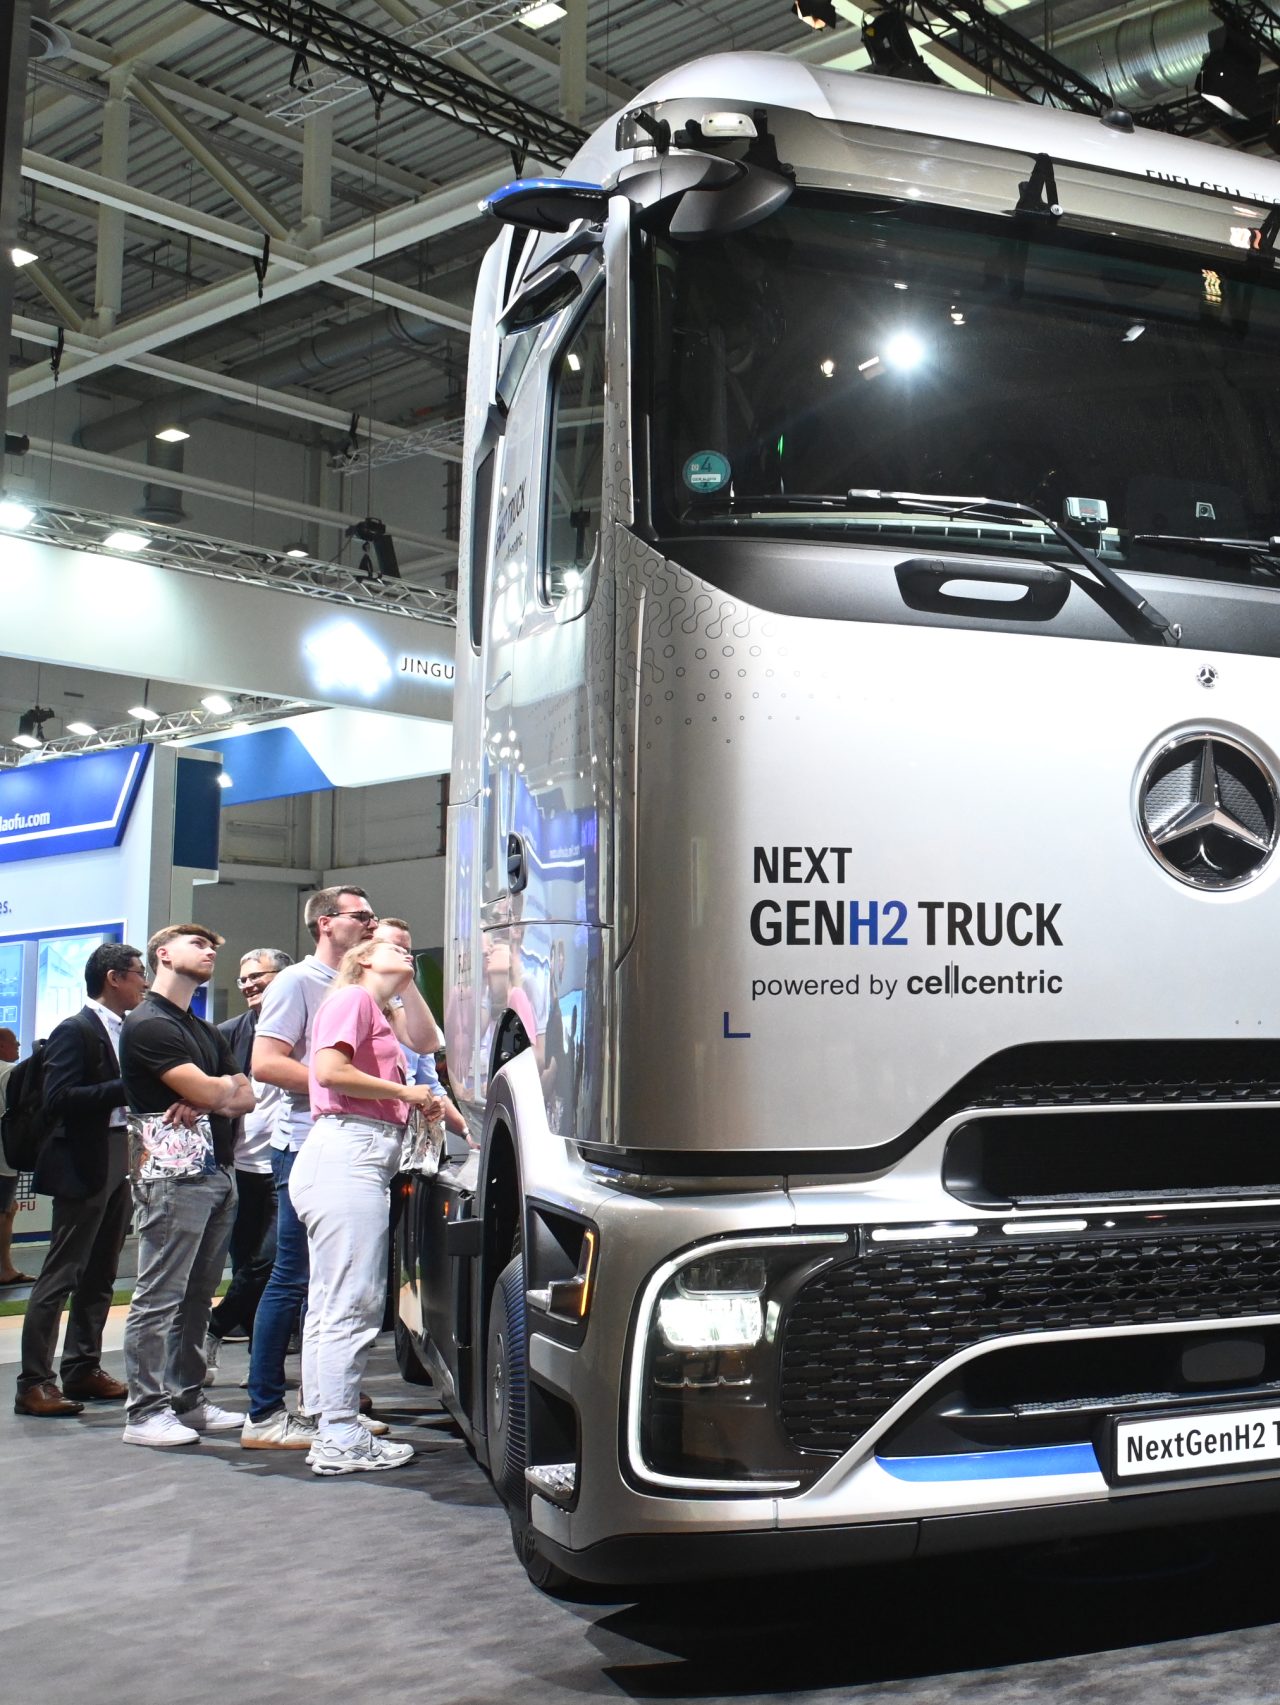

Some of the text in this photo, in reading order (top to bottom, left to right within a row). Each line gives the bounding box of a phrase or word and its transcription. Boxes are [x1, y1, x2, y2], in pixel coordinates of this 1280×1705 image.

[700, 456, 712, 472] 4
[401, 657, 455, 680] JINGU
[753, 846, 852, 884] NEXT
[750, 899, 1064, 947] GENH2 TRUCK
[752, 962, 1063, 1001] powered by cellcentric
[15, 1200, 36, 1211] FU
[1127, 1422, 1266, 1463] NextGenH2
